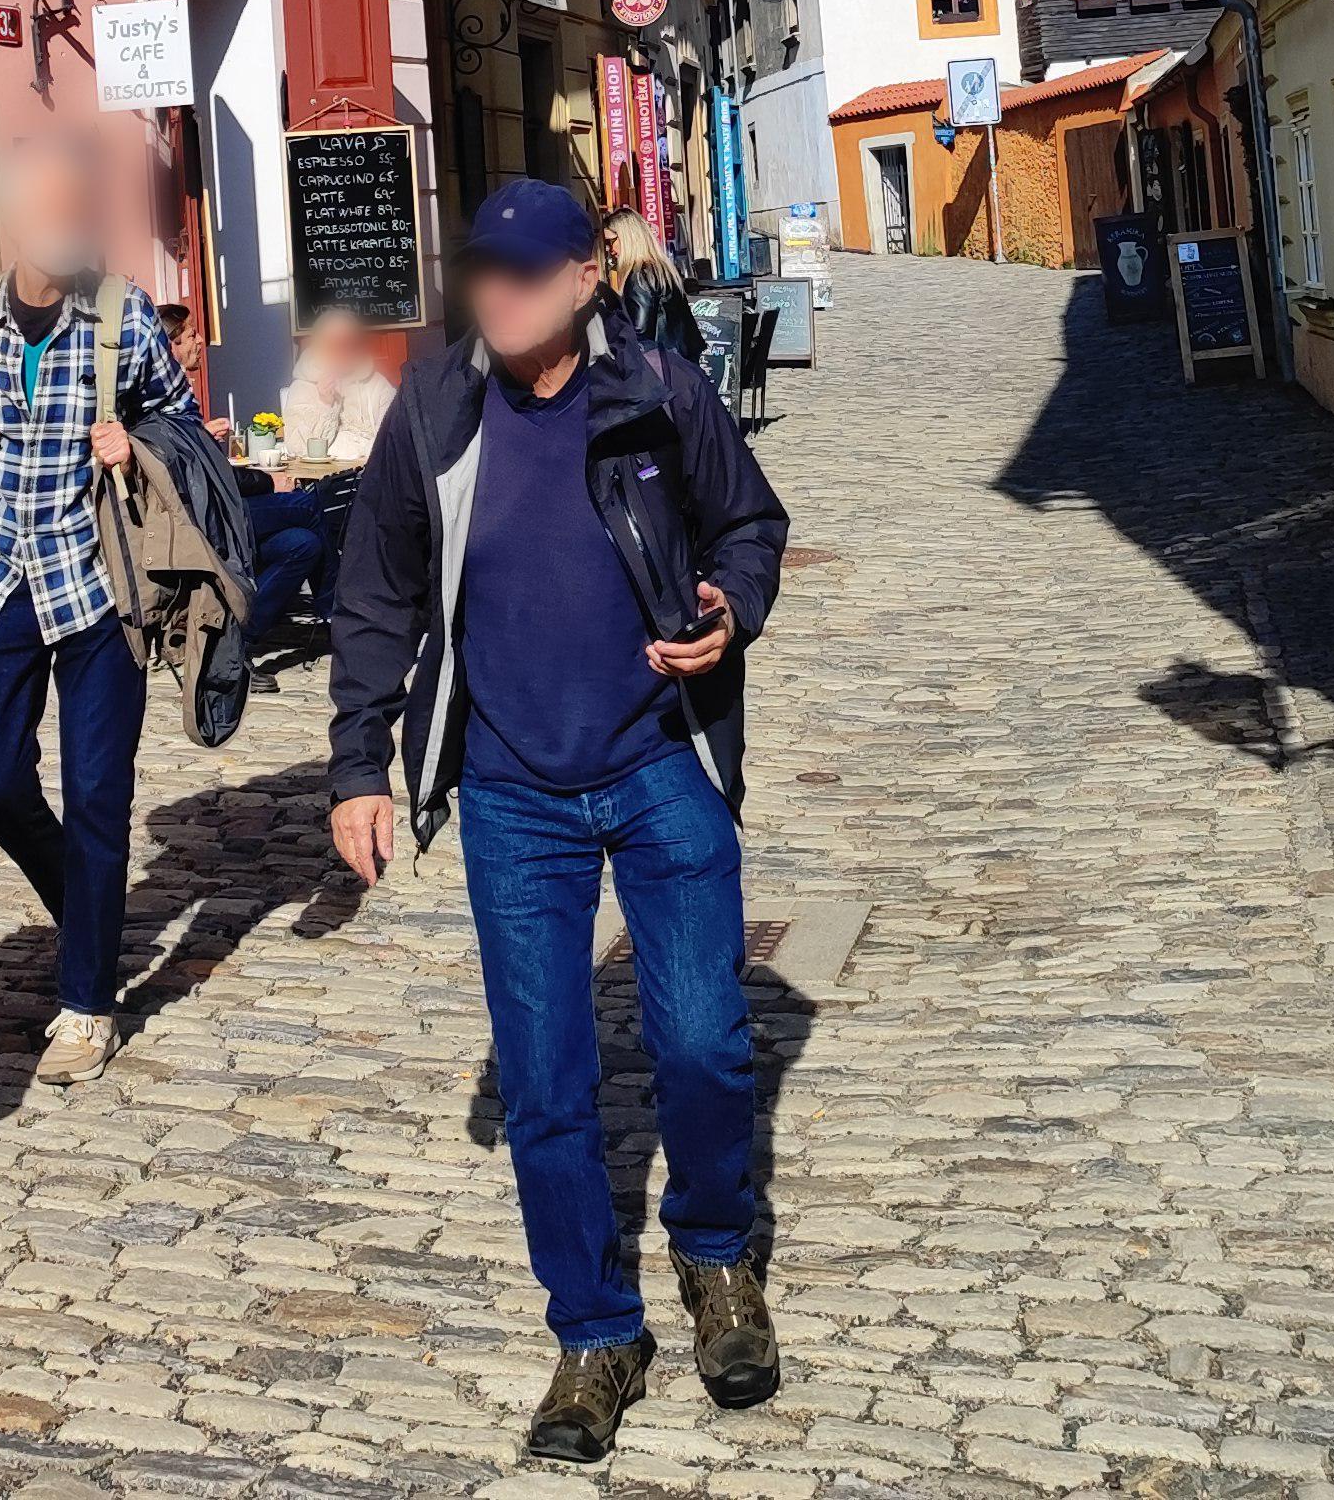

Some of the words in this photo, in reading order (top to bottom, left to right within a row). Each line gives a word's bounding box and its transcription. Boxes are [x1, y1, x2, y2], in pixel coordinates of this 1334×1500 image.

[106, 15, 179, 40] Justy's
[120, 43, 165, 62] CAFE
[137, 63, 149, 79] &
[103, 80, 188, 101] BISCUITS
[607, 63, 622, 103] SHOP
[610, 108, 624, 147] WINE
[298, 155, 365, 169] ESPRESSO
[298, 172, 375, 187] CAPPUCCINO
[303, 191, 345, 204] LATTE
[306, 207, 336, 220] FLAT
[338, 206, 371, 218] WHITE
[307, 239, 348, 253] LATTE
[308, 256, 385, 271] AFFOGATO
